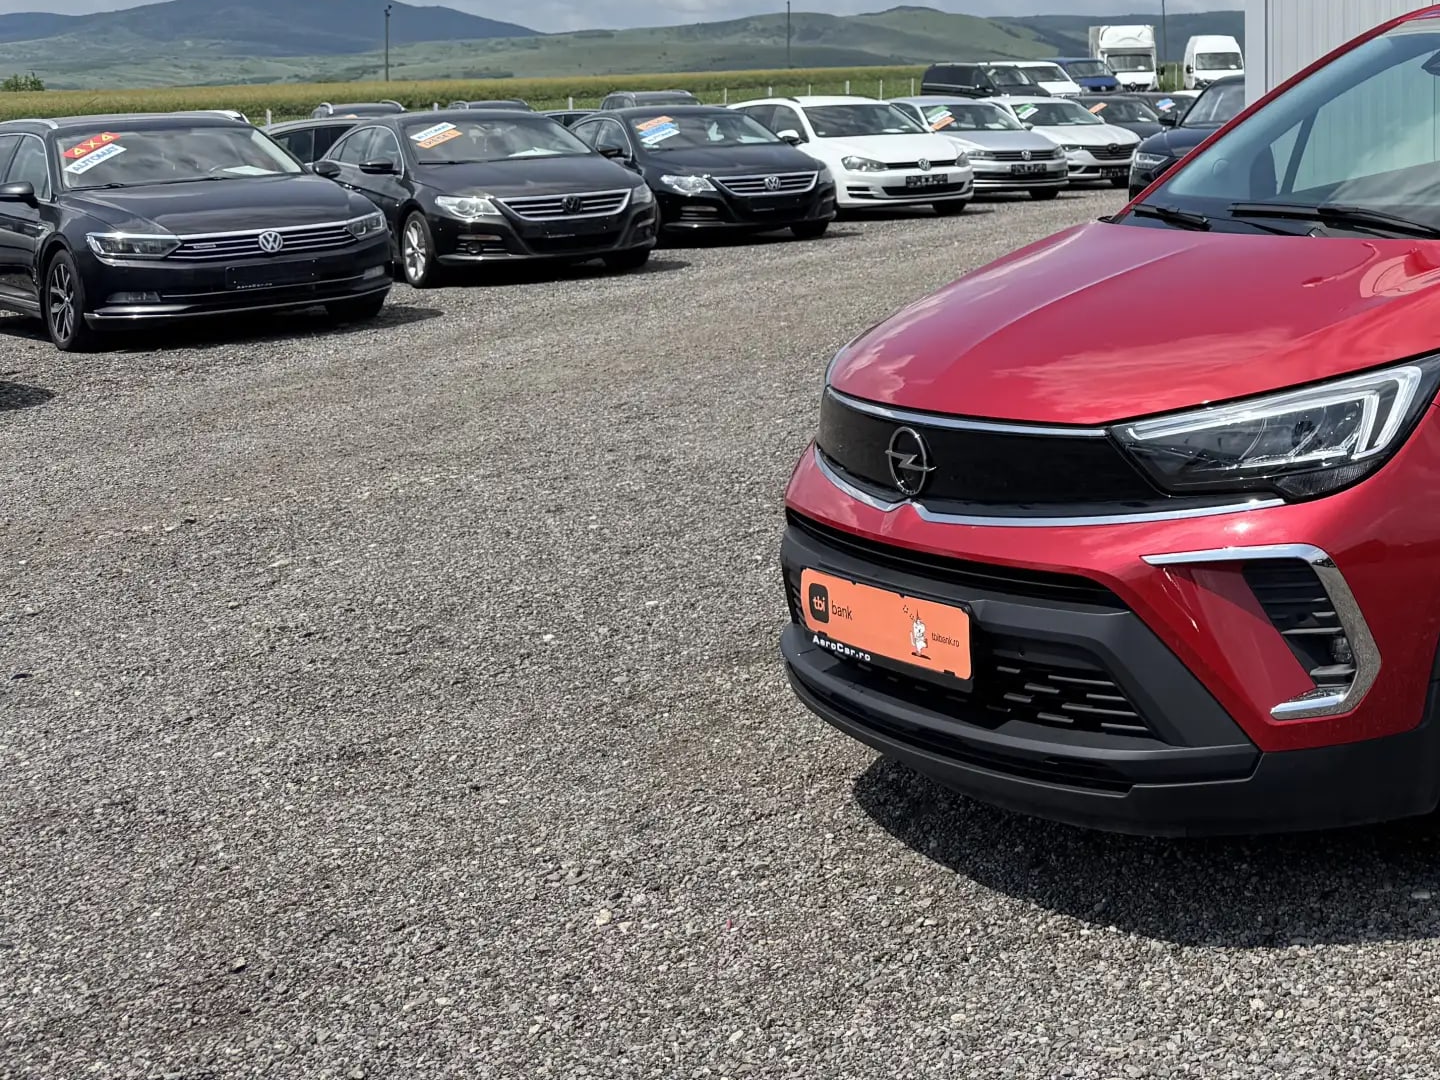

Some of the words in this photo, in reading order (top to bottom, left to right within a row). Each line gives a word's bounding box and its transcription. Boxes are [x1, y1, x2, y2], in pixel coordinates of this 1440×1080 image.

[71, 145, 118, 171] AUTOMAT
[812, 595, 826, 612] tbi
[831, 600, 853, 621] bank
[812, 634, 872, 662] AeroCar.ro
